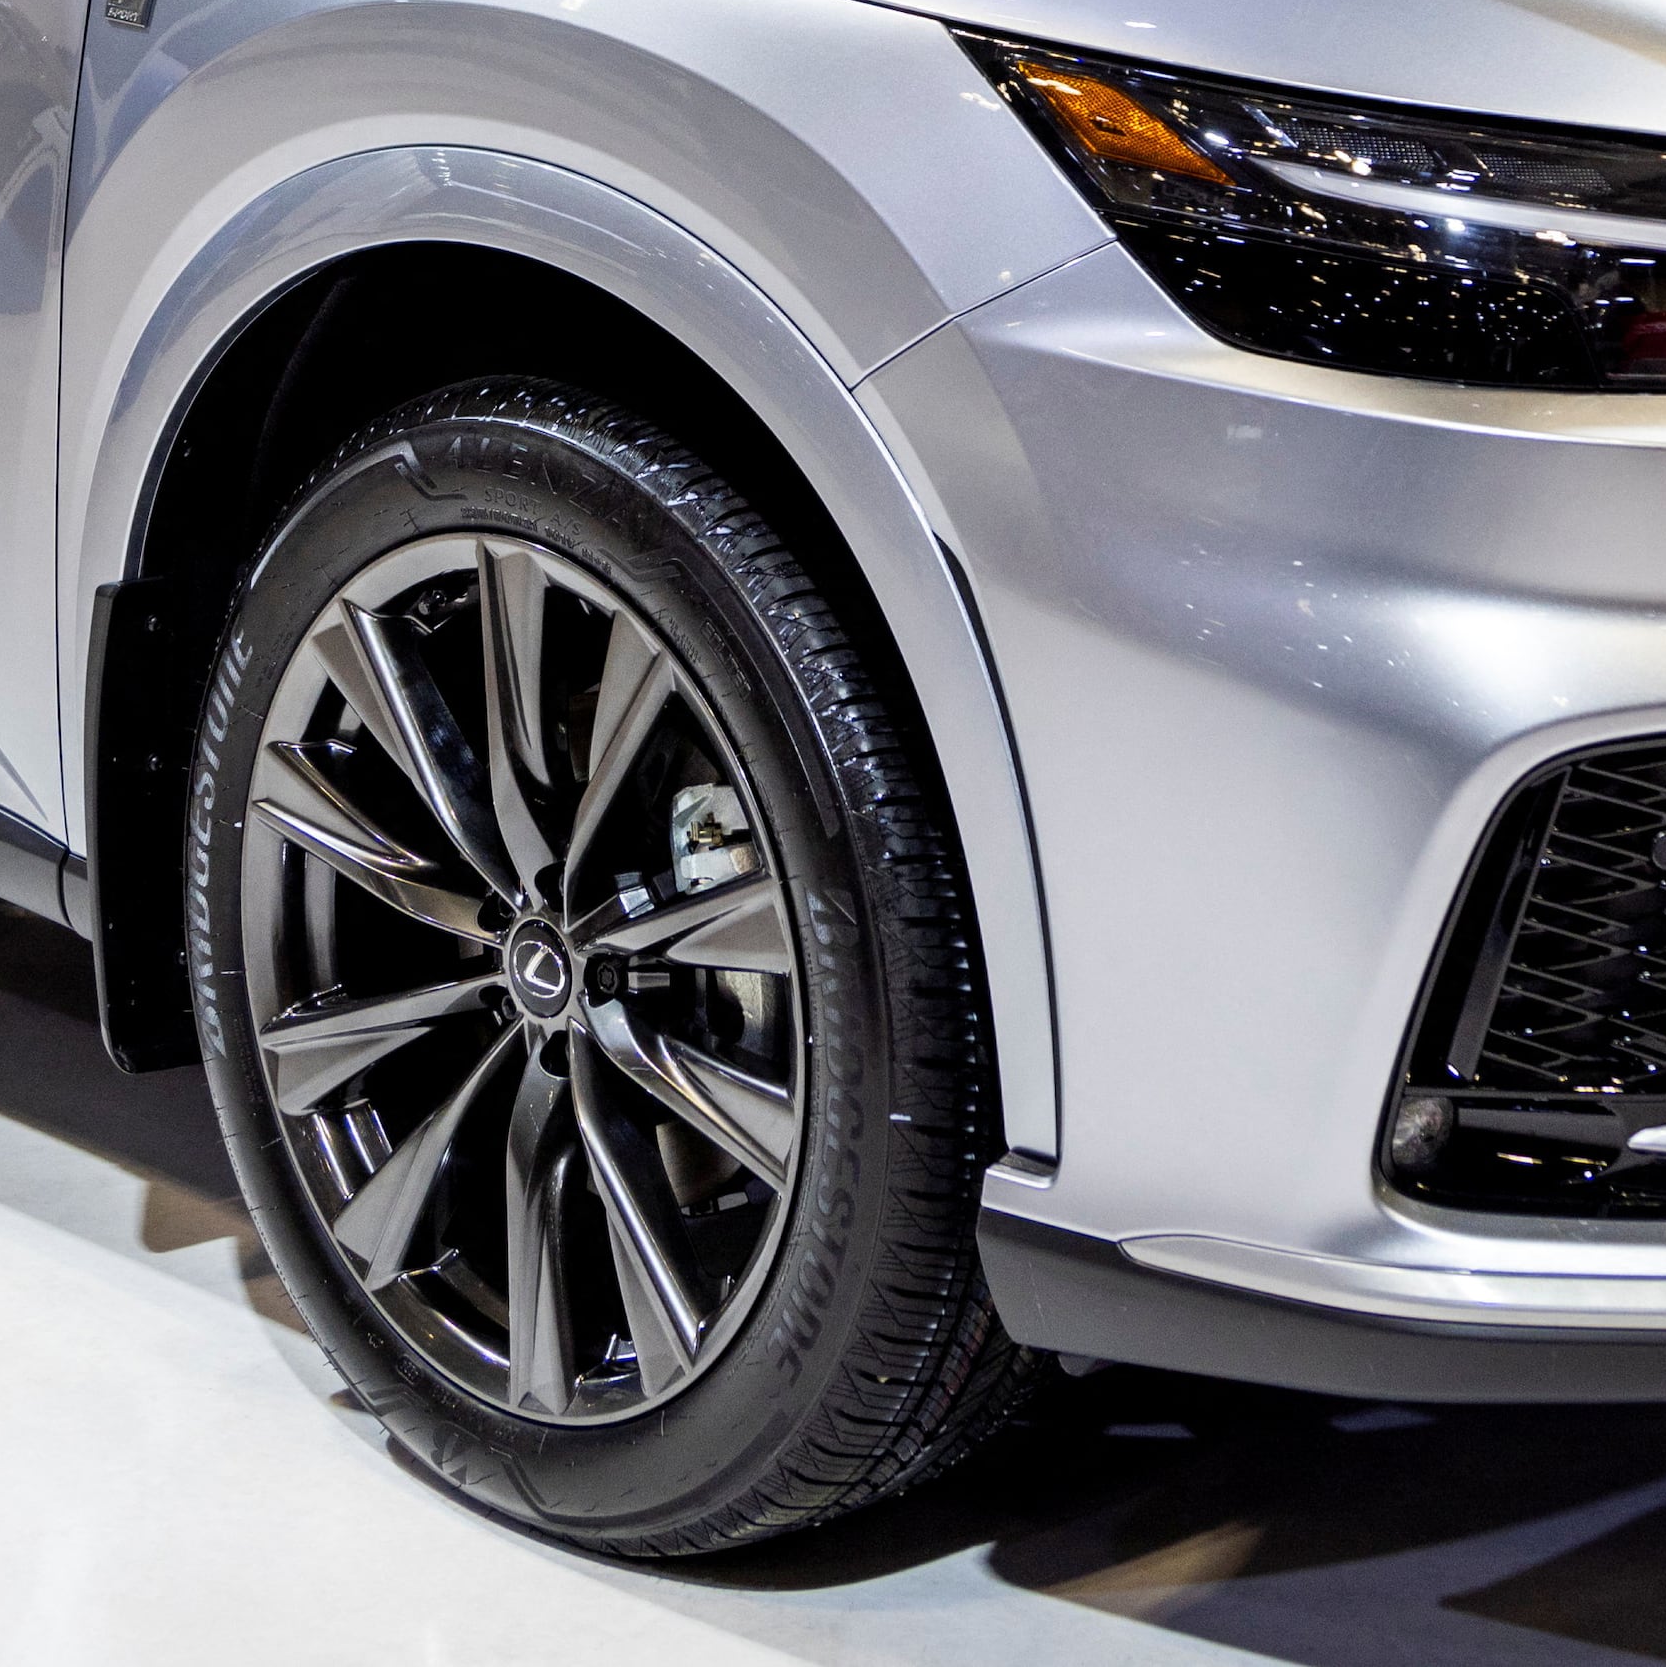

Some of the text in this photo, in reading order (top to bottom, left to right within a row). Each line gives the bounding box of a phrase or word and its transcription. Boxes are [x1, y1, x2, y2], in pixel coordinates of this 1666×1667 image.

[107, 7, 139, 22] SPORT
[483, 486, 541, 516] SPORT
[186, 627, 254, 1060] BRIDGESTONE
[765, 884, 864, 1392] BRIDGESTONE
